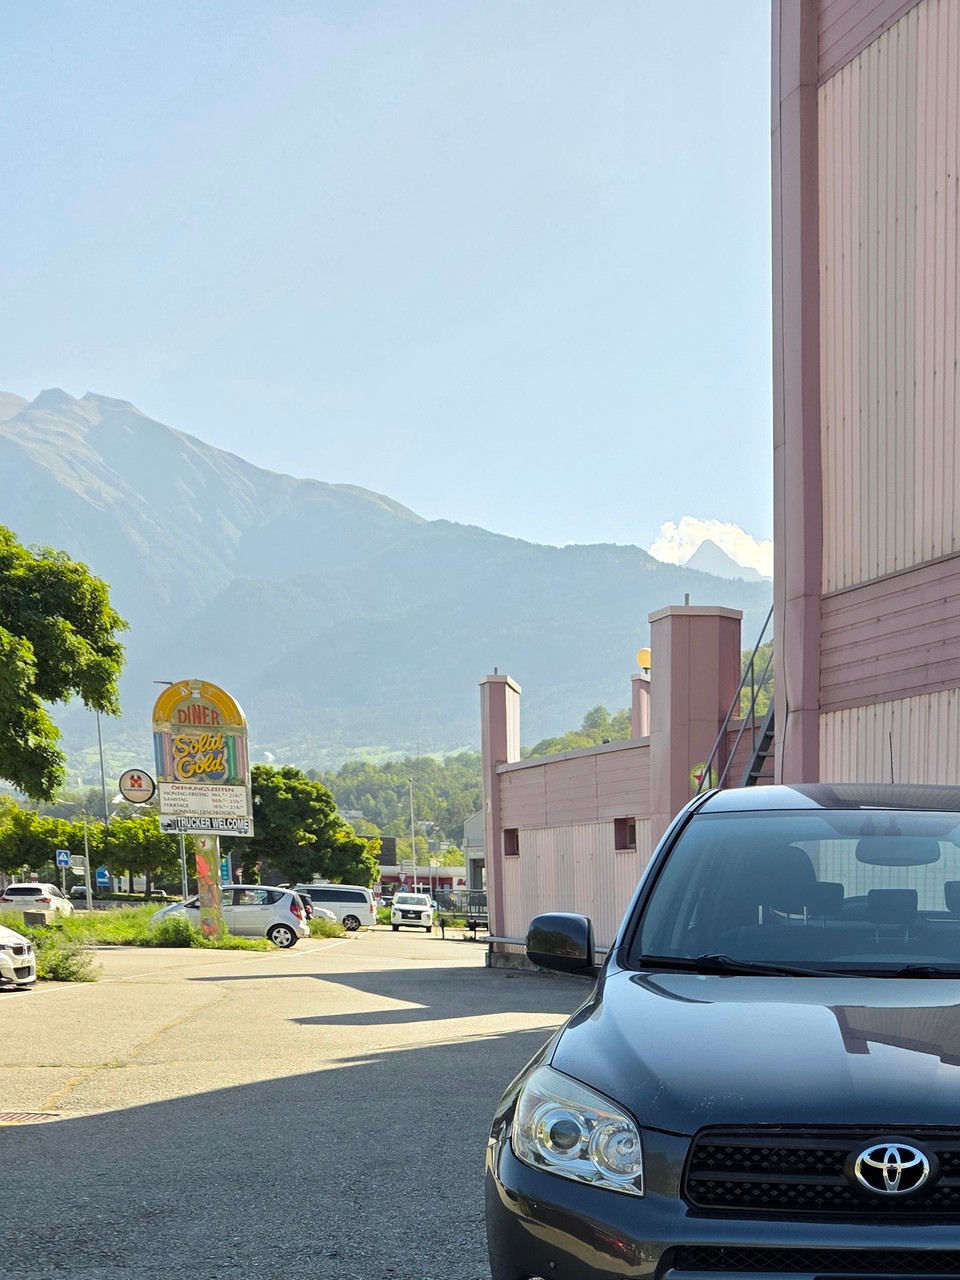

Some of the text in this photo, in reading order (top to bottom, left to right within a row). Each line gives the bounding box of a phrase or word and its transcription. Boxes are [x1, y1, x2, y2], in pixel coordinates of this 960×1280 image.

[178, 704, 220, 725] DINER
[173, 733, 225, 758] Solid
[178, 754, 225, 778] Gold
[177, 817, 249, 830] TRUCKER WELCOME
